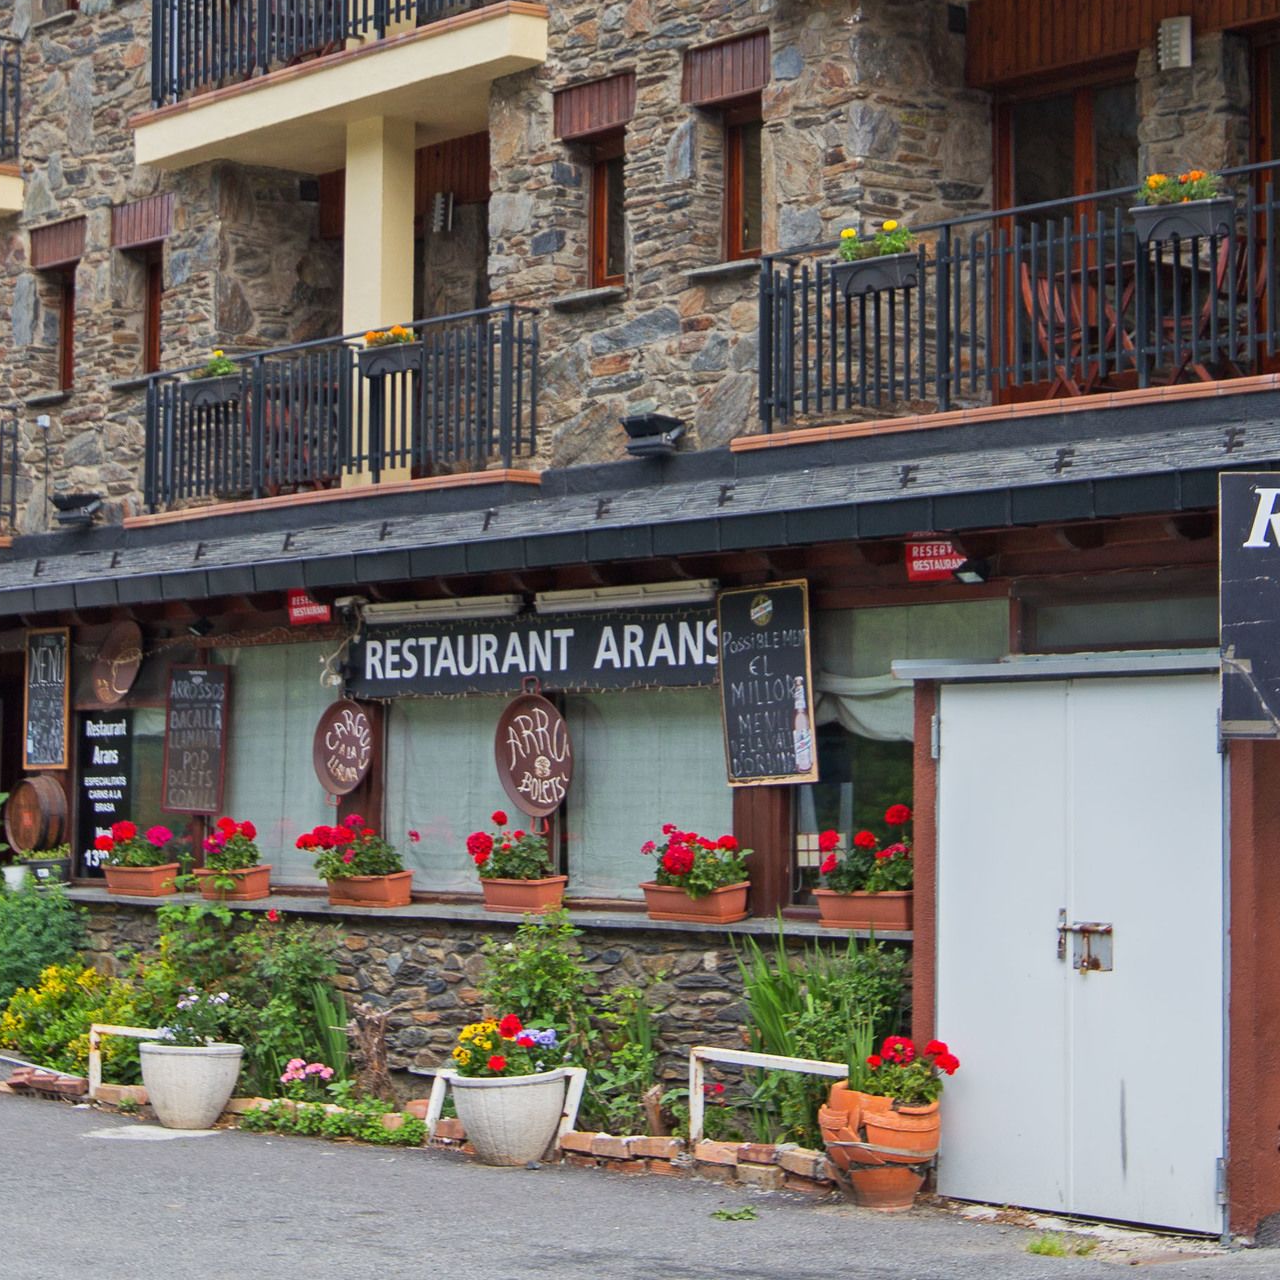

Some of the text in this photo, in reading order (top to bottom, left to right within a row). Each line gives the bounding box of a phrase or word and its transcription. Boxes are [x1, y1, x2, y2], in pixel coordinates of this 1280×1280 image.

[365, 619, 718, 680] RESTAURANT ARANS
[86, 720, 126, 736] Restaurant
[92, 745, 119, 765] Arans
[183, 750, 209, 771] POP
[84, 776, 127, 787] ESPECIALITATS
[94, 802, 115, 813] BRASA
